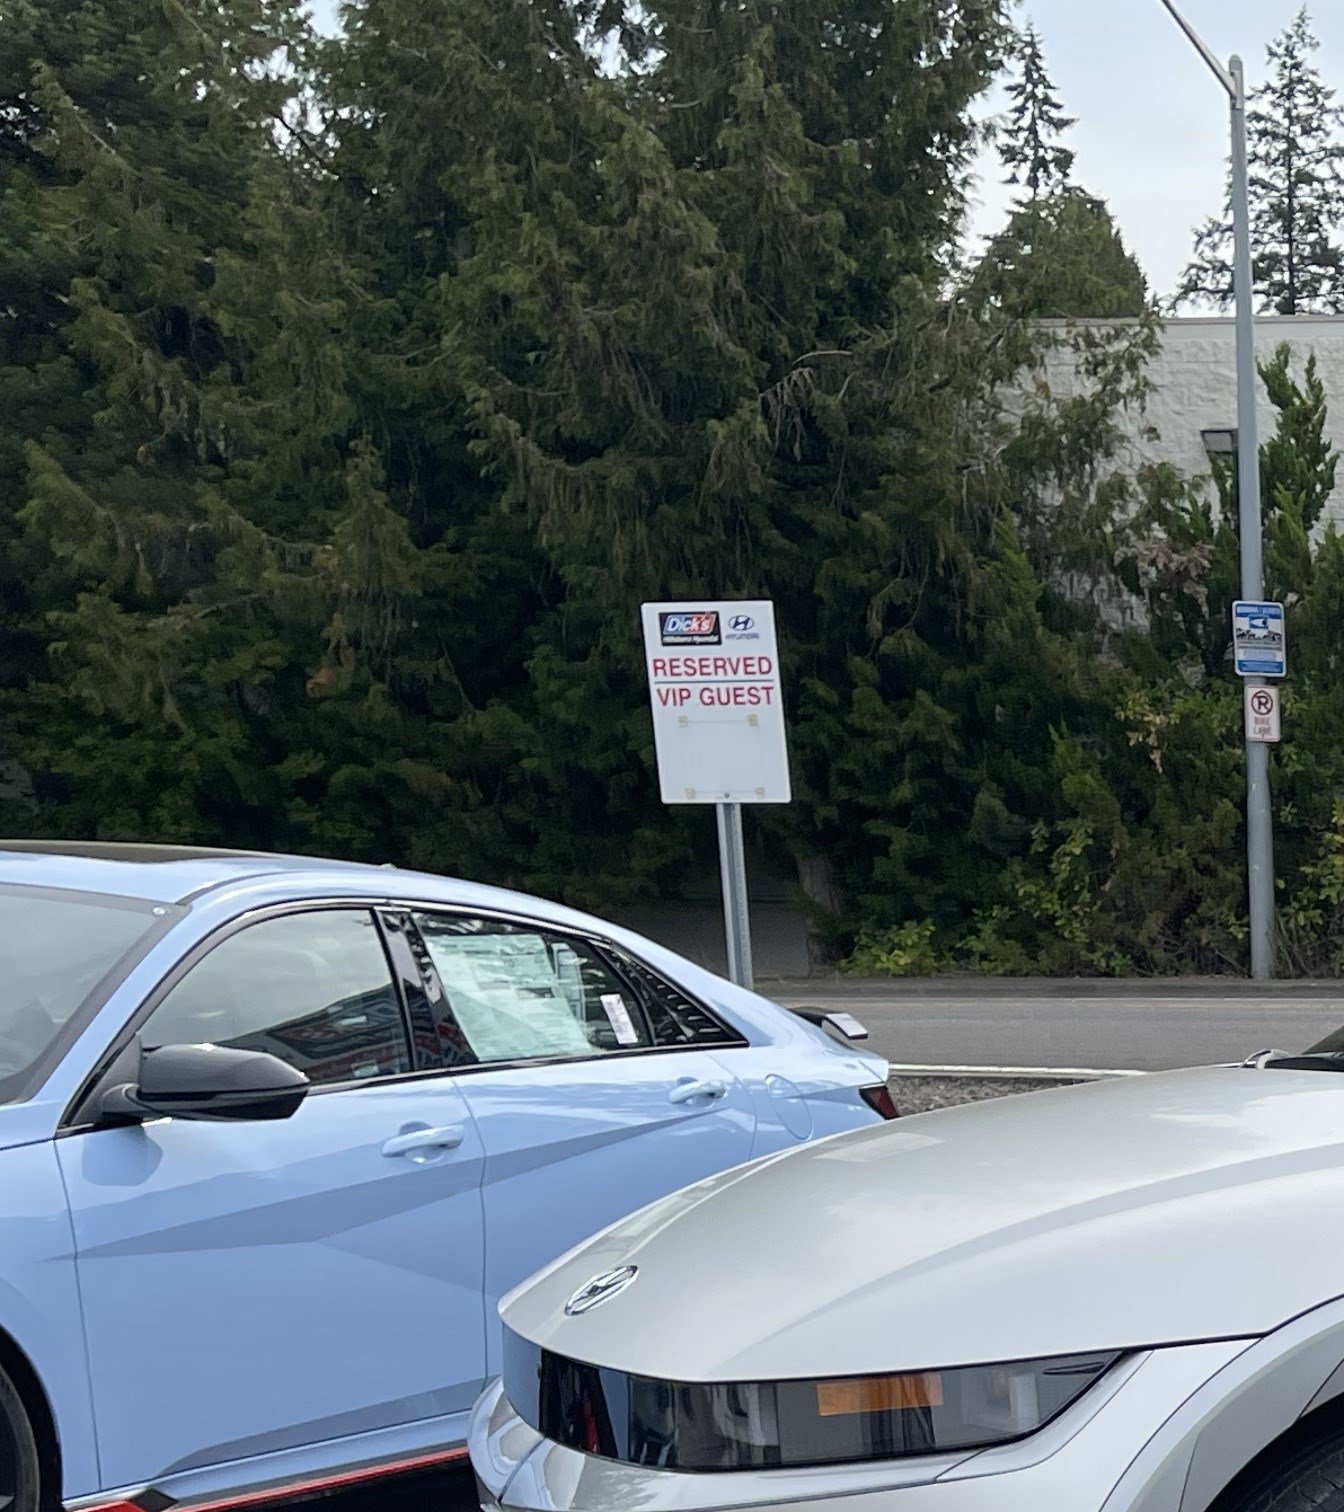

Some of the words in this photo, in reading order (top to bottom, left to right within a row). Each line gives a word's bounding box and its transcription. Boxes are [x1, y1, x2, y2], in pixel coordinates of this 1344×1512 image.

[653, 656, 772, 677] RESERVED
[657, 687, 691, 706] VIP
[699, 686, 774, 706] GUEST
